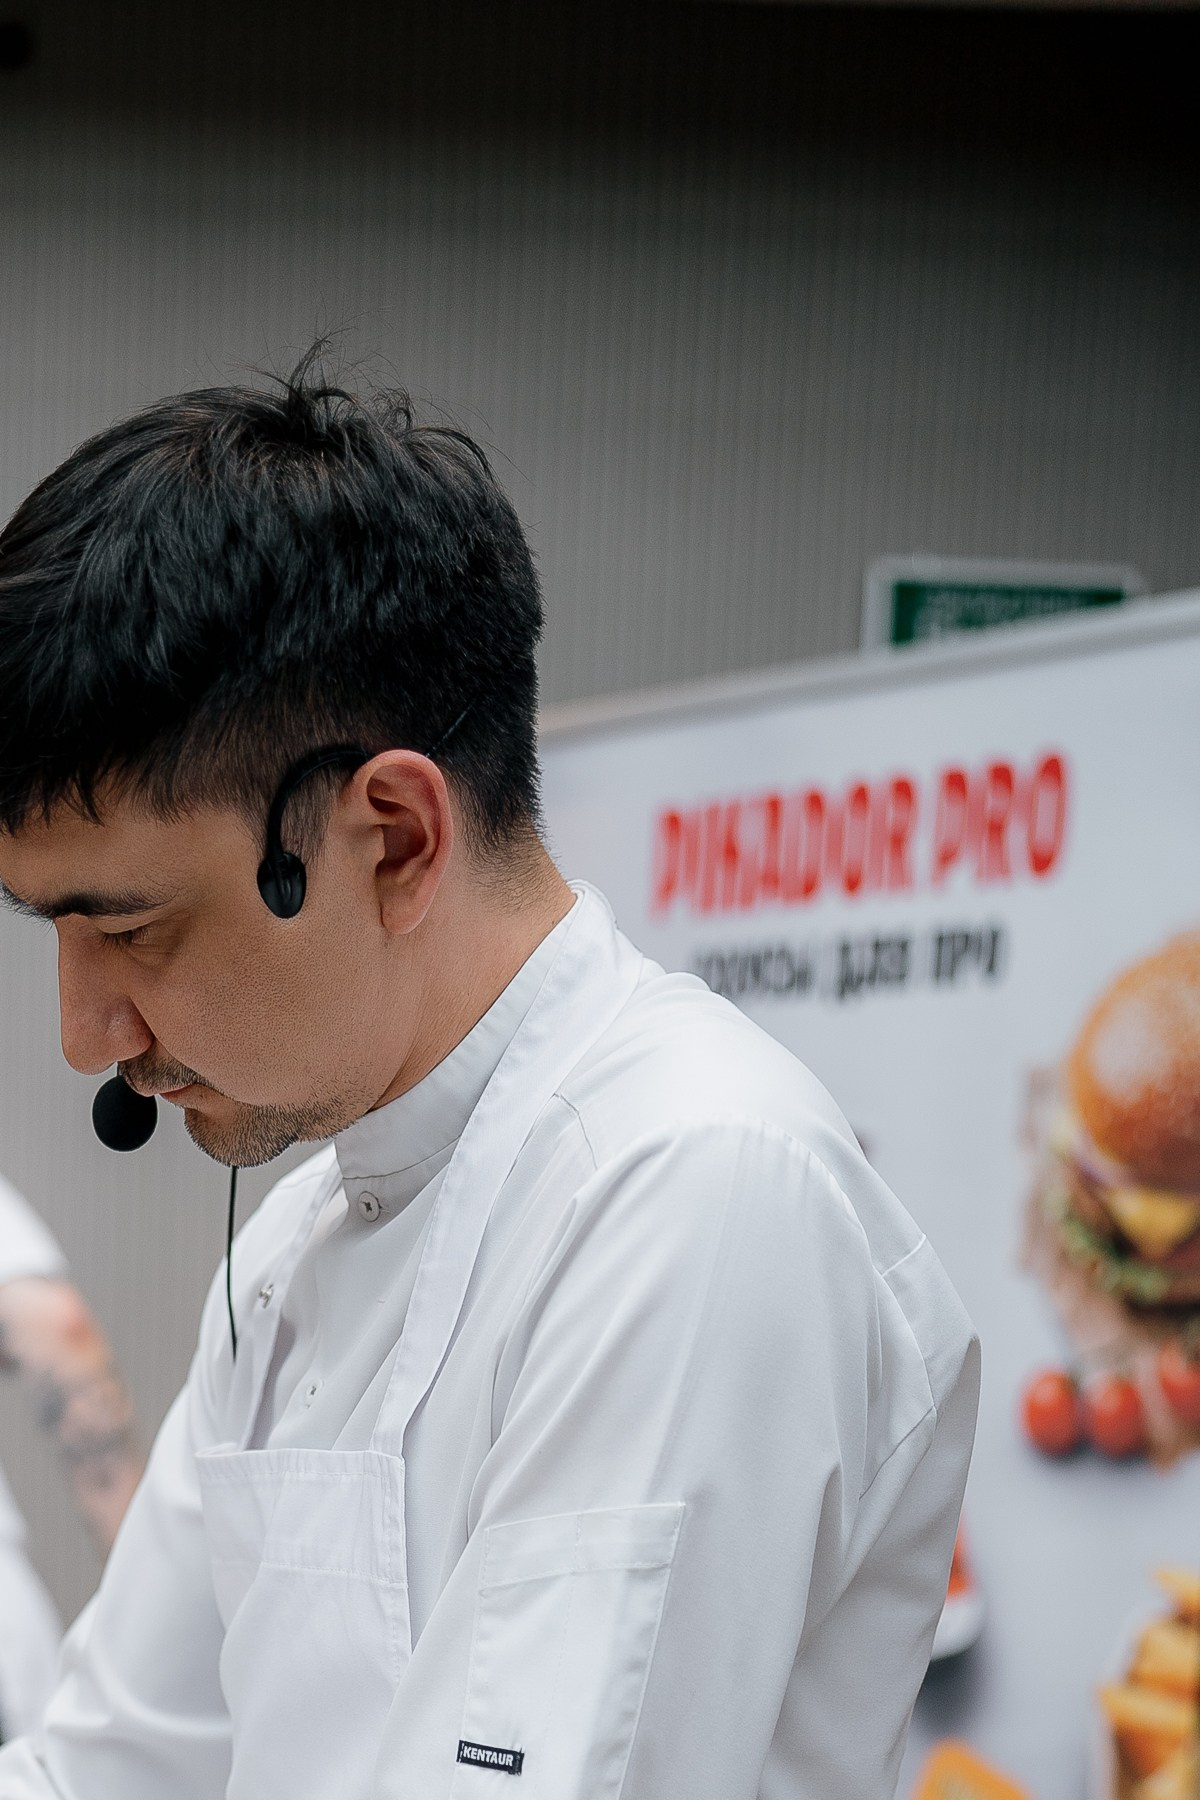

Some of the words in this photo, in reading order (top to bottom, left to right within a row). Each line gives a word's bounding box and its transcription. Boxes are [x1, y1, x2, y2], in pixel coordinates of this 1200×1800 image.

[651, 776, 917, 921] PIKADOR
[930, 752, 1067, 887] PRO
[463, 1745, 514, 1767] KENTAUR
